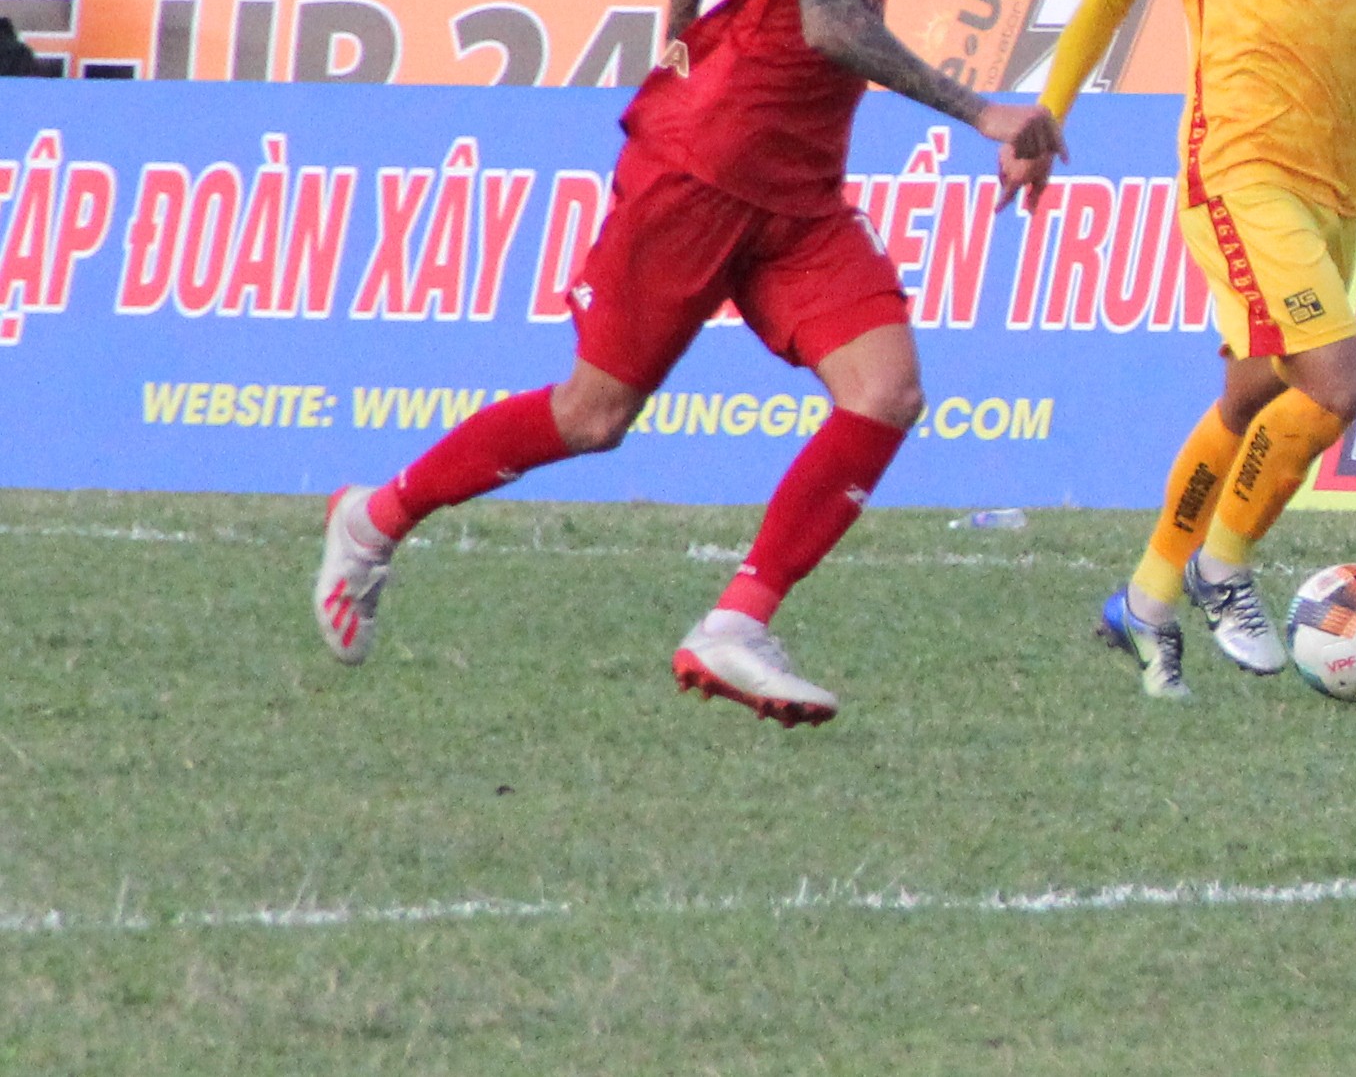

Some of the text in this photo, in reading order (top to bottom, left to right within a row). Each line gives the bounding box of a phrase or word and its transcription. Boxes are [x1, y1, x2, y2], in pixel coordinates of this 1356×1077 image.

[0, 129, 117, 347] ẬP
[115, 133, 356, 320] ĐOÀN
[349, 137, 535, 322] XÂY
[1005, 174, 1222, 333] TRUN
[142, 382, 336, 427] WEBSITE:
